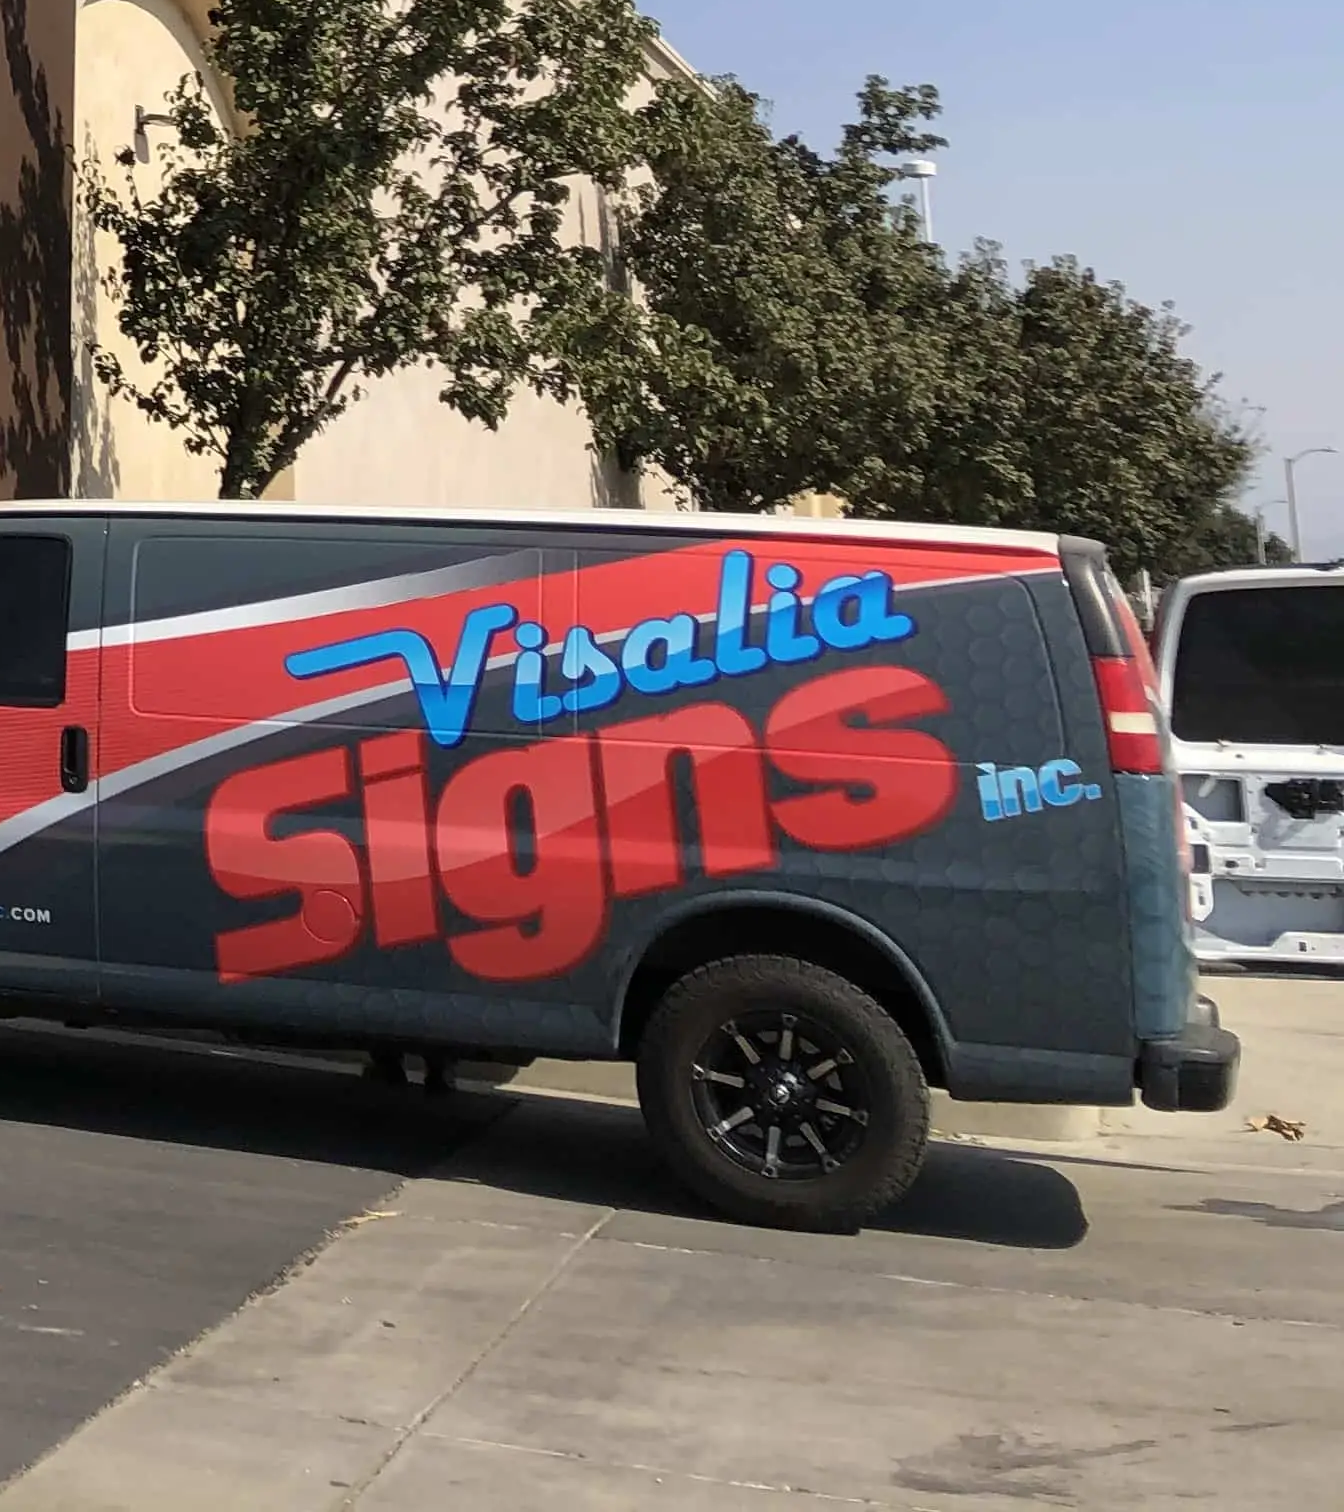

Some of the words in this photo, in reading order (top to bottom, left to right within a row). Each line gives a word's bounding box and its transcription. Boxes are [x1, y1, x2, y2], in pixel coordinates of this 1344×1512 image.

[283, 548, 914, 749] Visalia
[204, 663, 958, 984] Signs
[975, 758, 1103, 822] inc.
